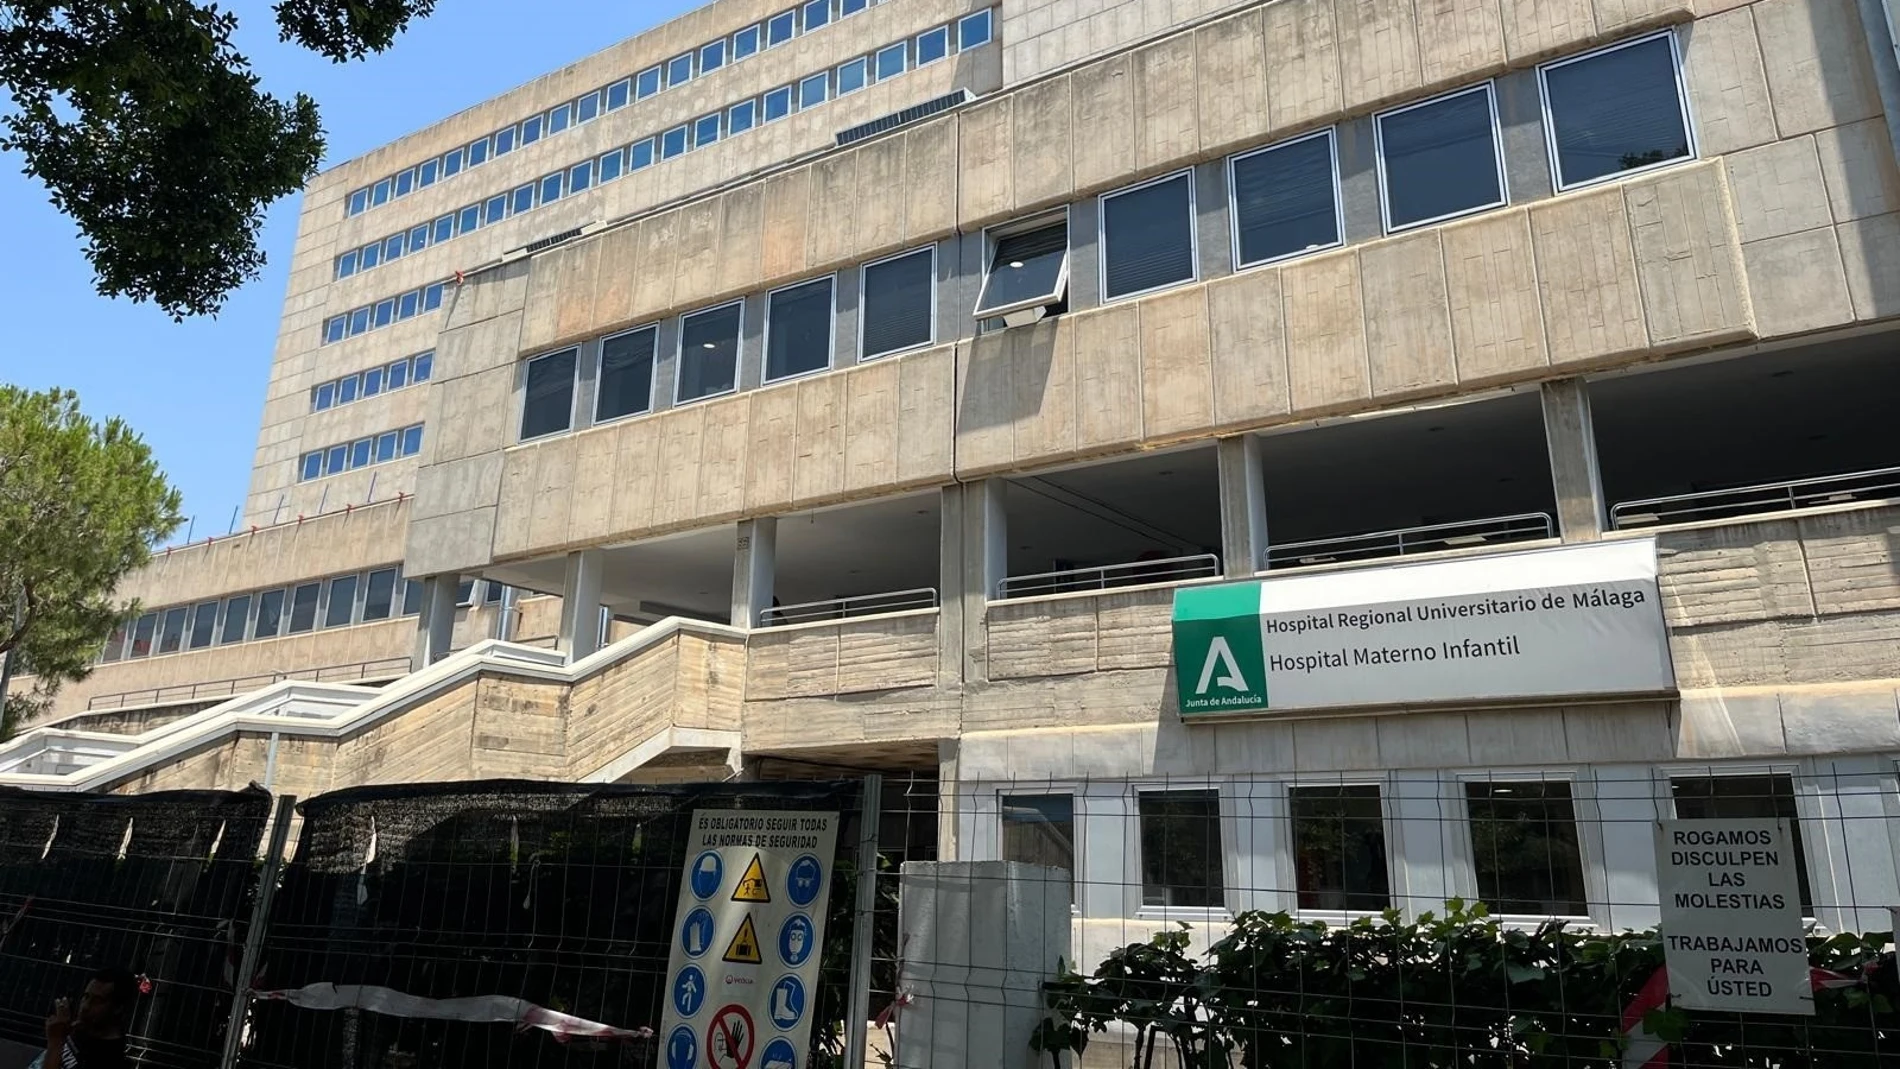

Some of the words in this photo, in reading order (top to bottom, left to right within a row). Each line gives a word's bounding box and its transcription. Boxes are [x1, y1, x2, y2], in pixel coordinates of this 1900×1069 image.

[1266, 613, 1334, 634] Hospital
[1338, 606, 1413, 630] Regional
[1416, 595, 1537, 621] Universitario
[1541, 593, 1565, 610] de
[1572, 588, 1646, 609] Málaga
[1269, 648, 1349, 674] Hospital
[1353, 646, 1437, 667] Materno
[1443, 635, 1521, 660] Infantil
[1185, 698, 1208, 708] Junta
[1209, 697, 1220, 706] de
[1221, 694, 1262, 705] Andalucía
[710, 817, 764, 831] OBLIGATORIO
[766, 818, 798, 831] SEGUIR
[800, 818, 827, 832] TODAS
[702, 833, 717, 846] LAS
[719, 834, 753, 847] NORMAS
[755, 834, 767, 848] DE
[769, 835, 818, 848] SEGURIDAD
[1673, 830, 1772, 846] ROGAMOS
[1671, 851, 1779, 867] DISCULPEN
[1708, 872, 1746, 887] LAS
[1674, 893, 1785, 910] MOLESTIAS
[1667, 935, 1803, 954] TRABAJAMOS
[1710, 958, 1764, 975] PARA
